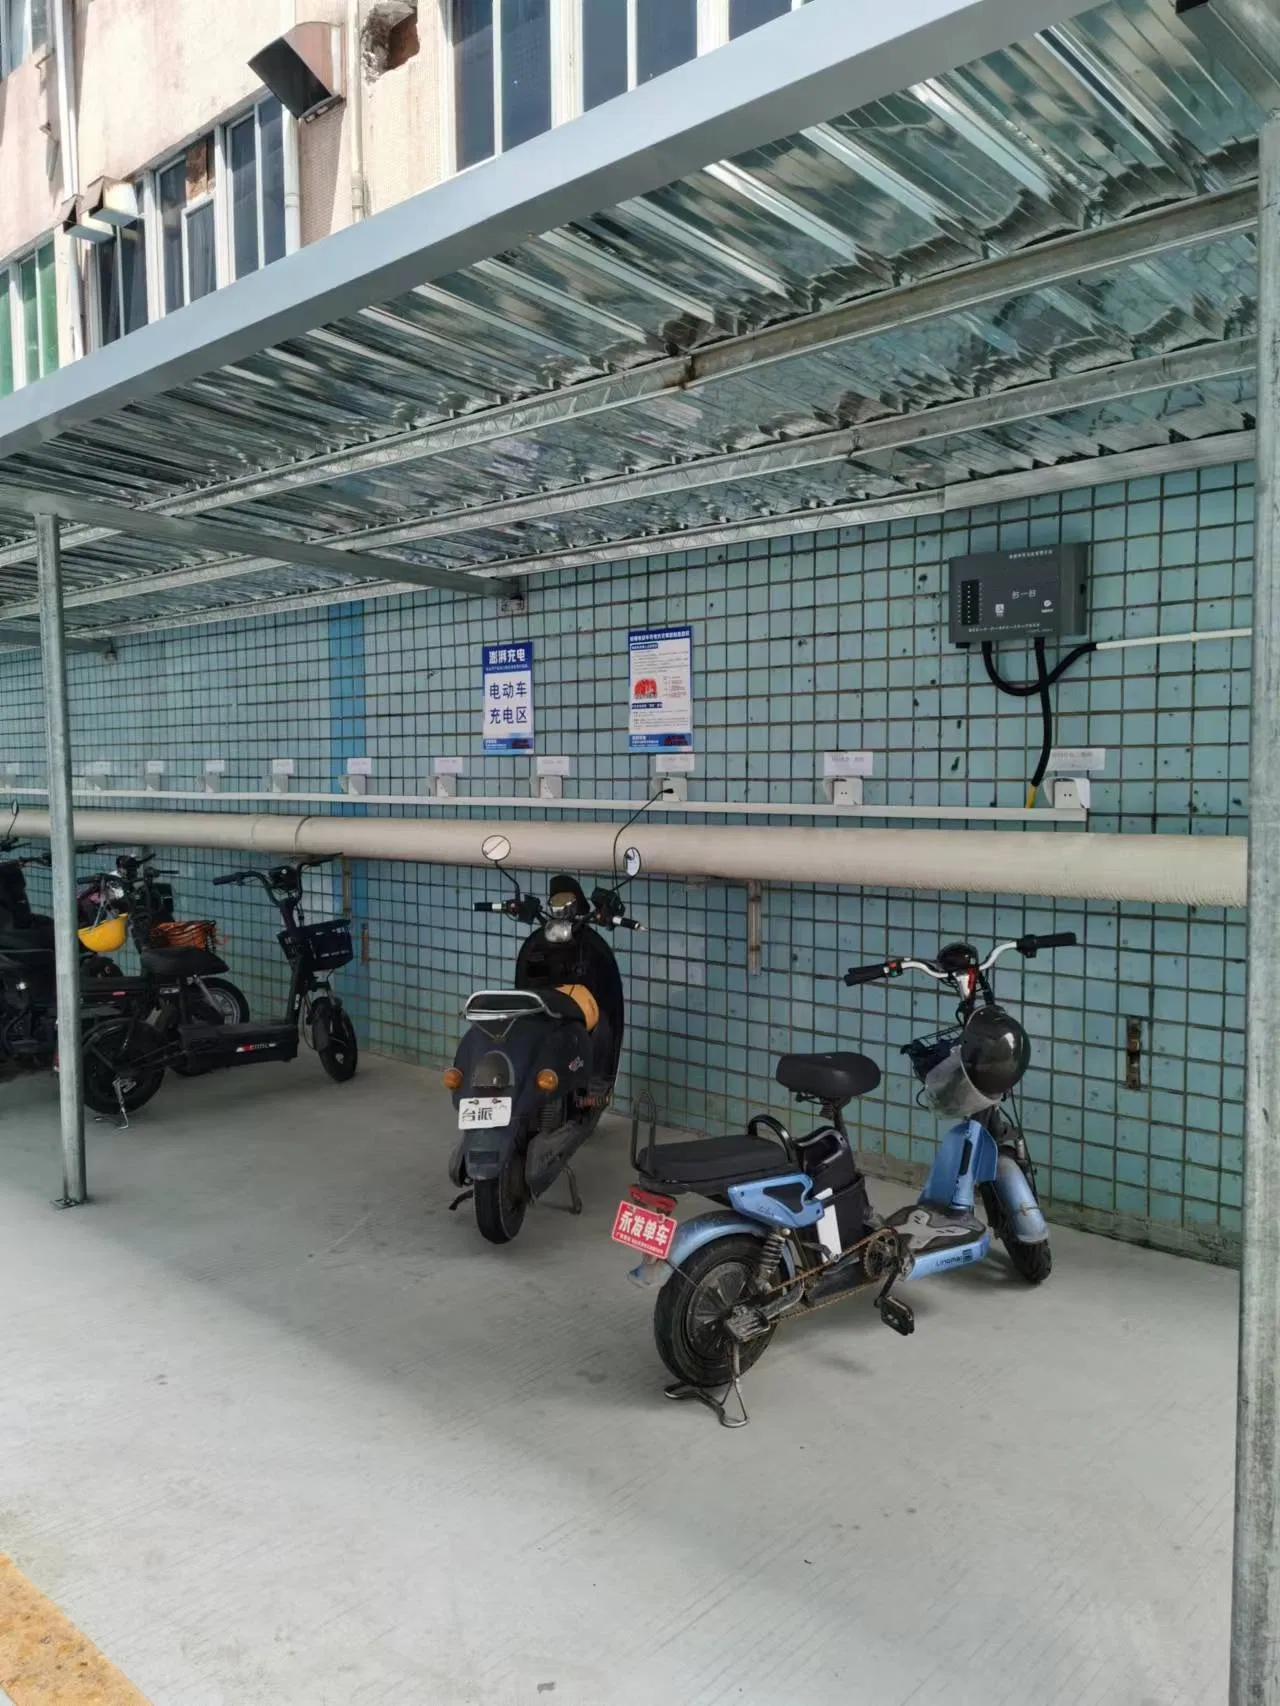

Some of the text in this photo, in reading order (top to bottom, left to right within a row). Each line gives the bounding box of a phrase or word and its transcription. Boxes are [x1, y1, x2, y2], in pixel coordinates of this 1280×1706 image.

[489, 680, 528, 700] 电动车
[489, 706, 529, 725] 充电区
[462, 1107, 493, 1122] 台派
